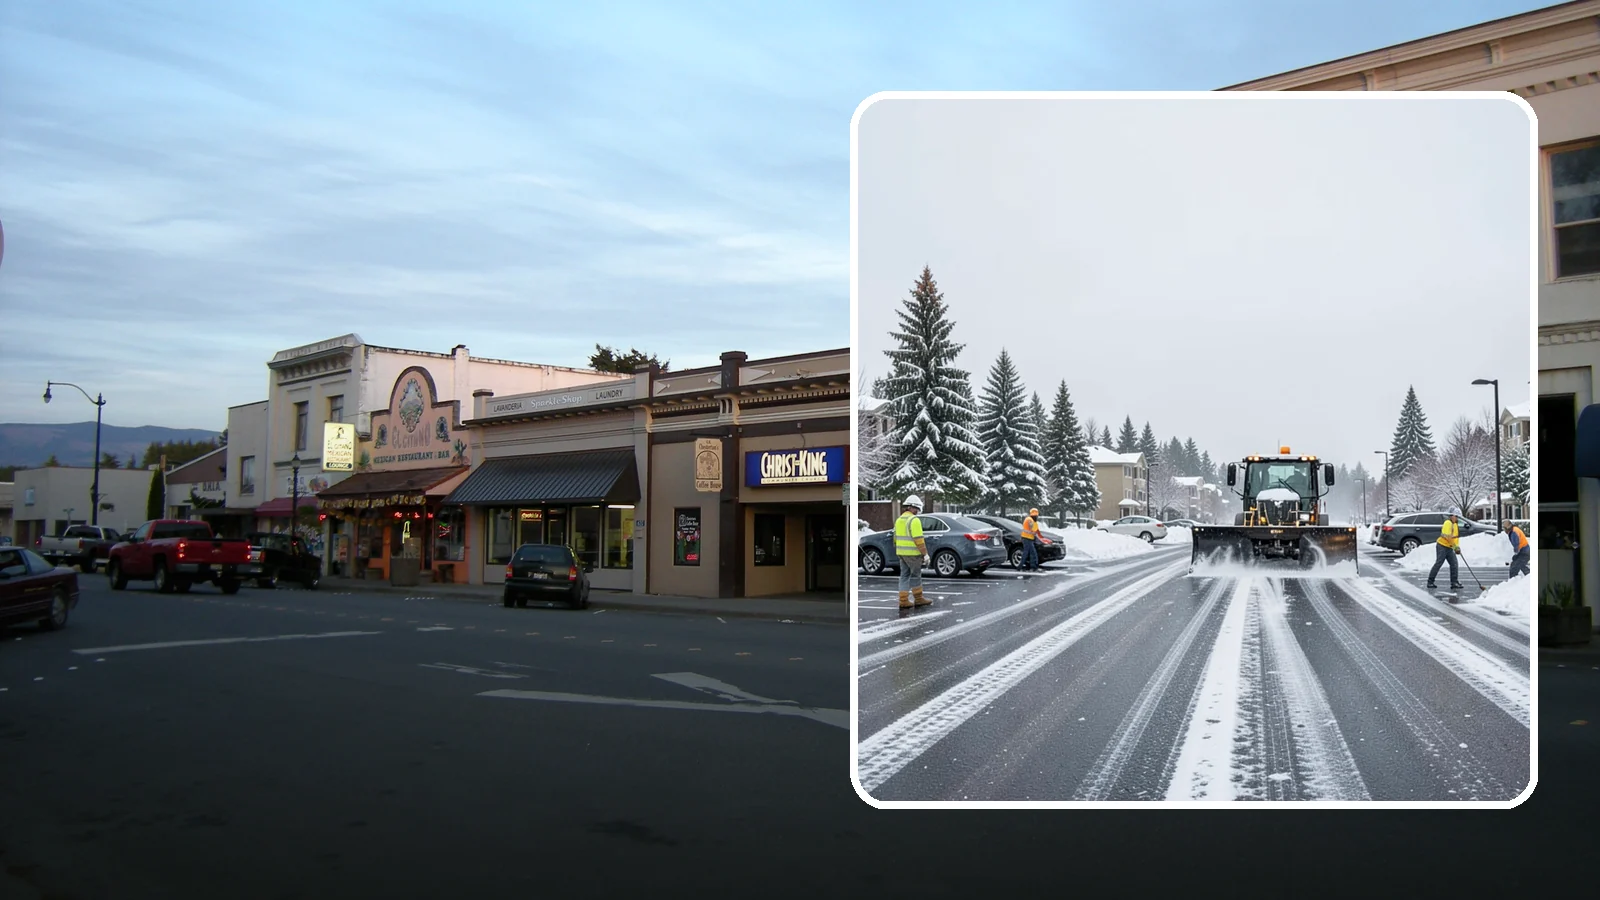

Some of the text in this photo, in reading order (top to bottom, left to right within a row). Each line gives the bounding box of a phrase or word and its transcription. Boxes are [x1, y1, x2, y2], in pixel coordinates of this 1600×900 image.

[595, 388, 623, 400] LAUNDRY
[493, 401, 523, 412] LAVANDERIA
[531, 394, 582, 410] Sparkle Shop
[373, 454, 396, 465] MEXICAN
[397, 451, 433, 463] RESTAURANT
[438, 450, 450, 459] BAR
[760, 449, 827, 478] CHRIST KING
[696, 481, 709, 489] Coffee
